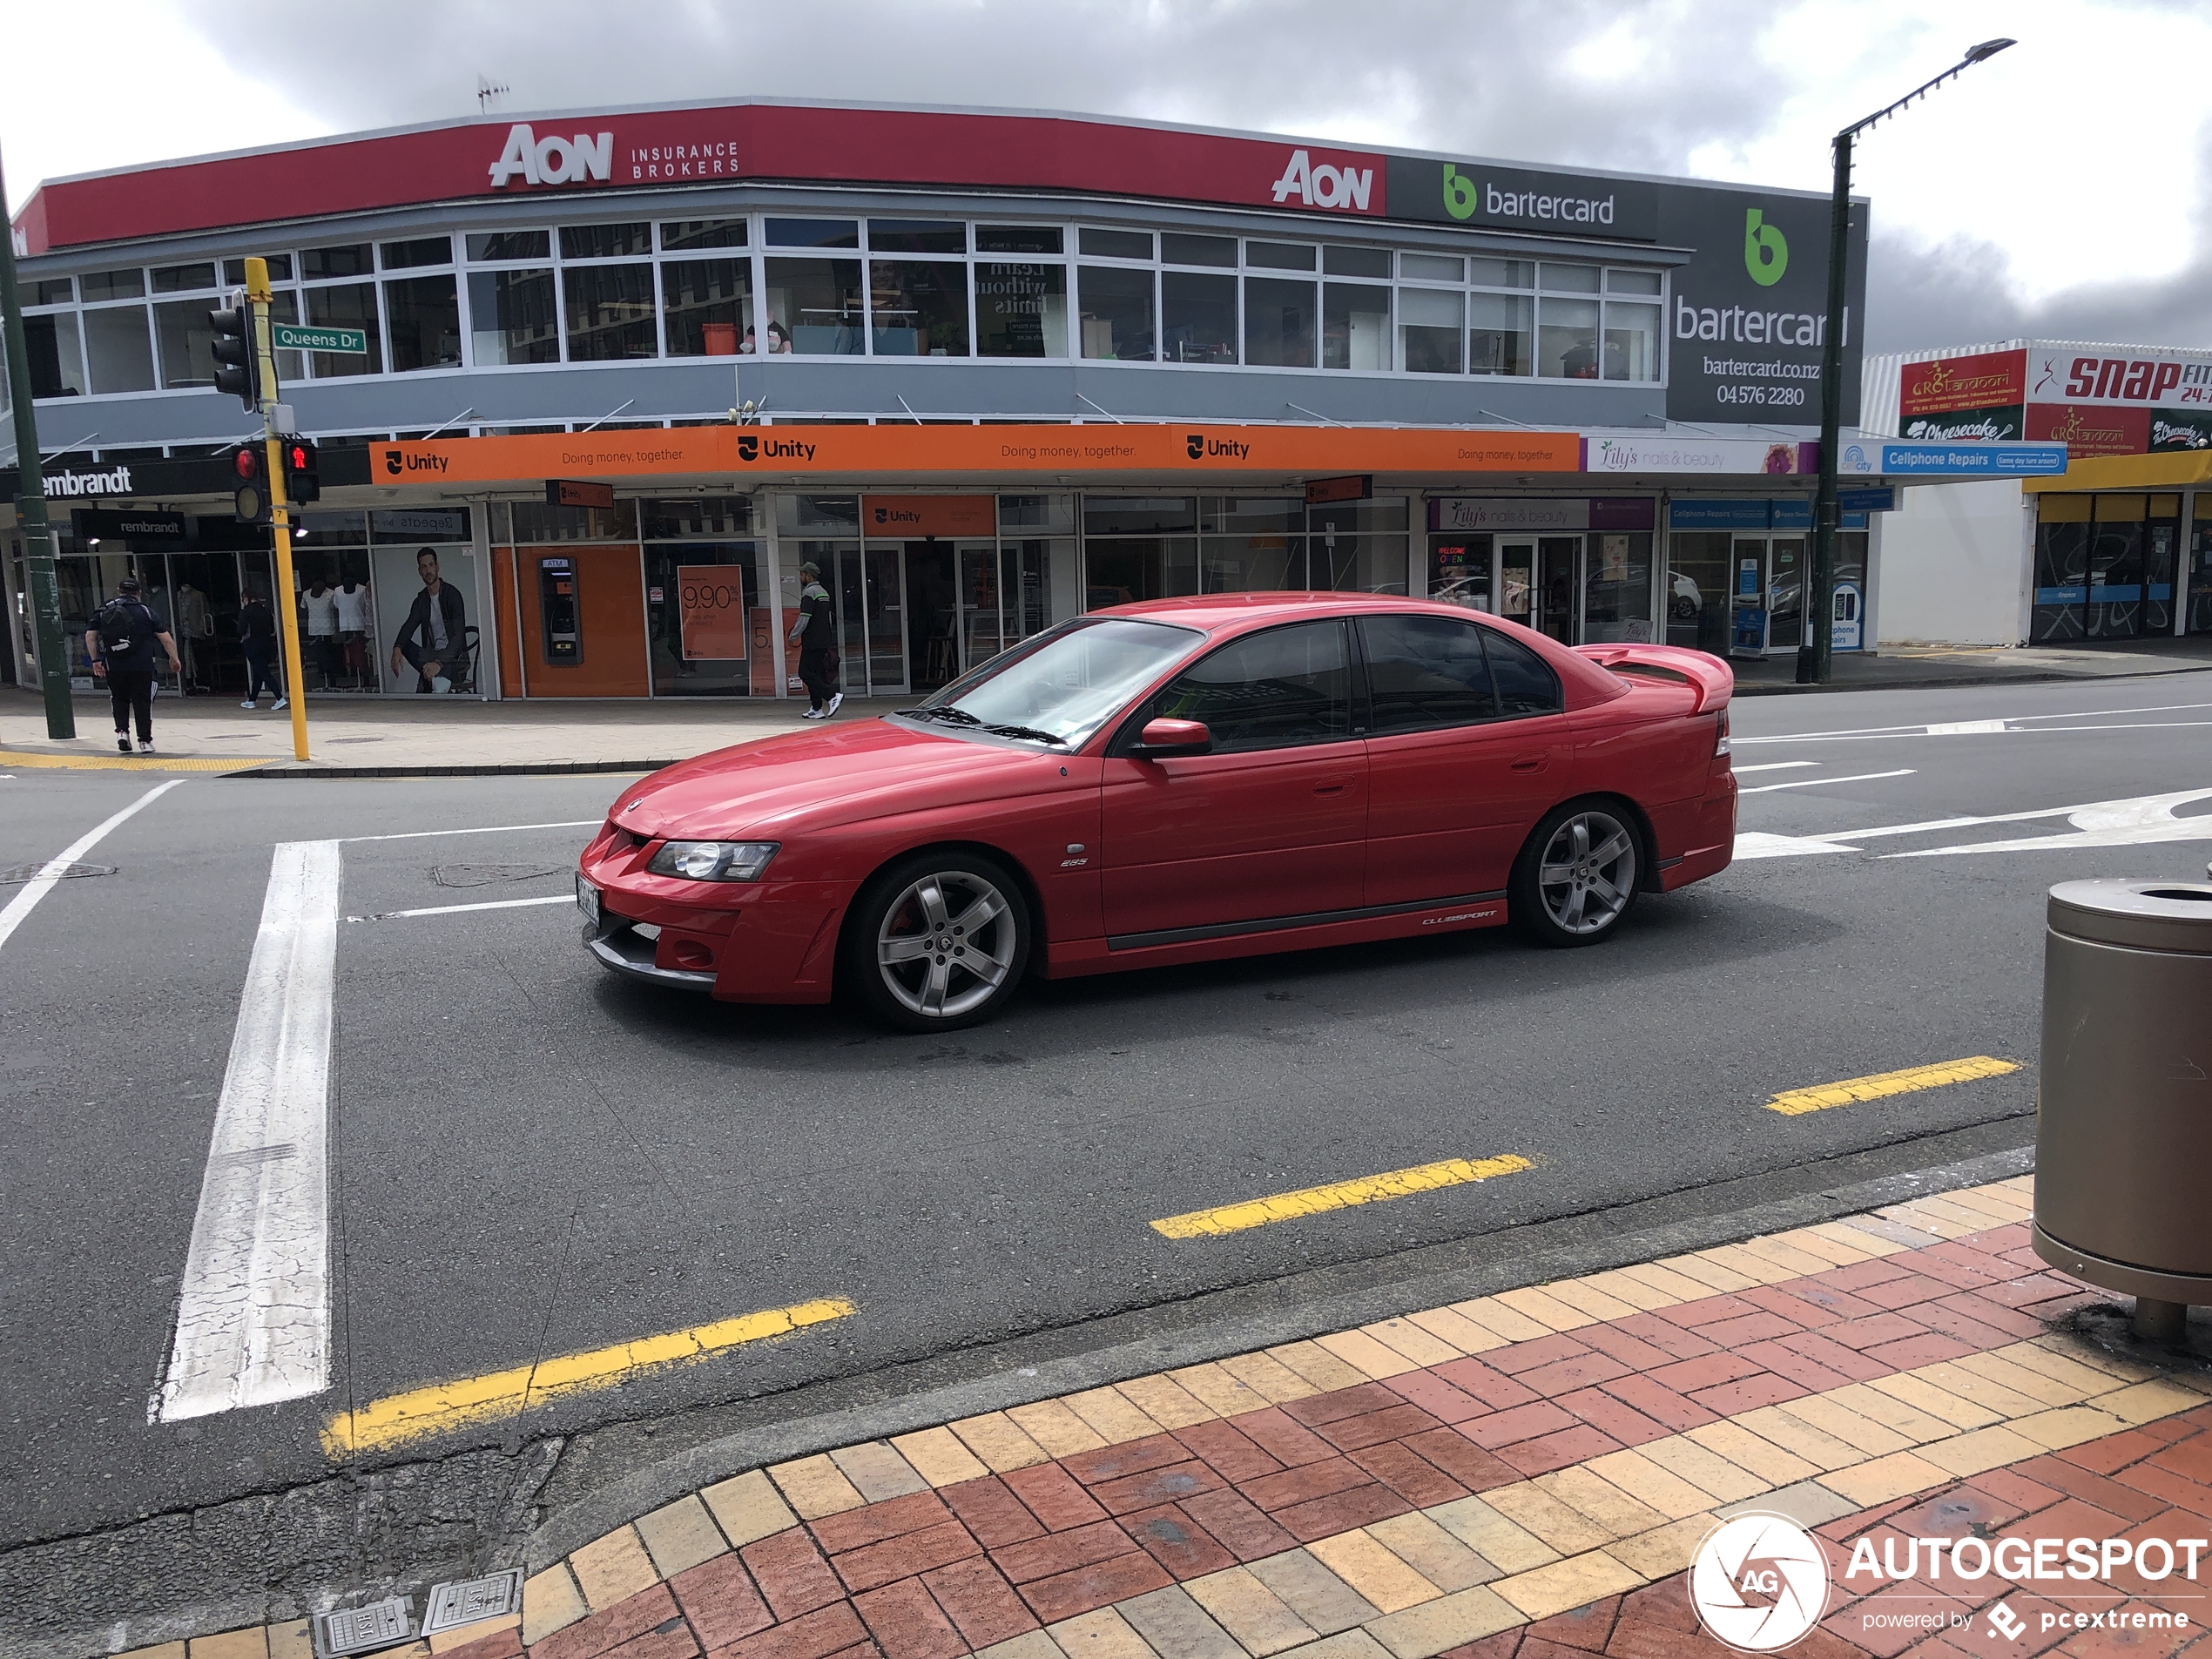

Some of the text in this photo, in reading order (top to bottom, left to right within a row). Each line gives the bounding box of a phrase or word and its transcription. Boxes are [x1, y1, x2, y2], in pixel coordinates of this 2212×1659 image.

[631, 142, 738, 163] INSURANCE
[633, 158, 738, 179] BROKERS
[1487, 182, 1614, 225] bartercard
[1676, 294, 1849, 347] bartercar
[280, 330, 358, 348] Queens Dr
[1703, 355, 1821, 379] bartercard.co.nz
[2182, 364, 2212, 385] FIT
[1768, 386, 1804, 406] 2280
[2153, 433, 2162, 445] The
[2161, 424, 2197, 441] Cheesecake
[562, 452, 594, 466] Doing
[596, 452, 635, 464] money,
[764, 439, 817, 462] Unity
[1001, 444, 1136, 459] Doing money, together.
[1208, 439, 1250, 460] Unity
[1458, 448, 1484, 462] Doing
[1485, 449, 1516, 461] money,
[1600, 447, 1725, 471] Lily's nails & beauty
[406, 452, 449, 473] Unity
[1889, 451, 1989, 469] Cellphone Repairs
[42, 466, 132, 496] embrandt
[889, 510, 921, 523] Unity
[1450, 502, 1568, 528] Lily's nails & beauty
[1673, 509, 1705, 519] Cellphone
[1706, 509, 1731, 518] Repairs
[120, 522, 179, 533] rembrandt
[1439, 546, 1466, 555] WELCOME
[1440, 554, 1463, 563] OPEN
[1422, 909, 1498, 925] CLUBSPORT
[357, 1613, 375, 1639] HSL
